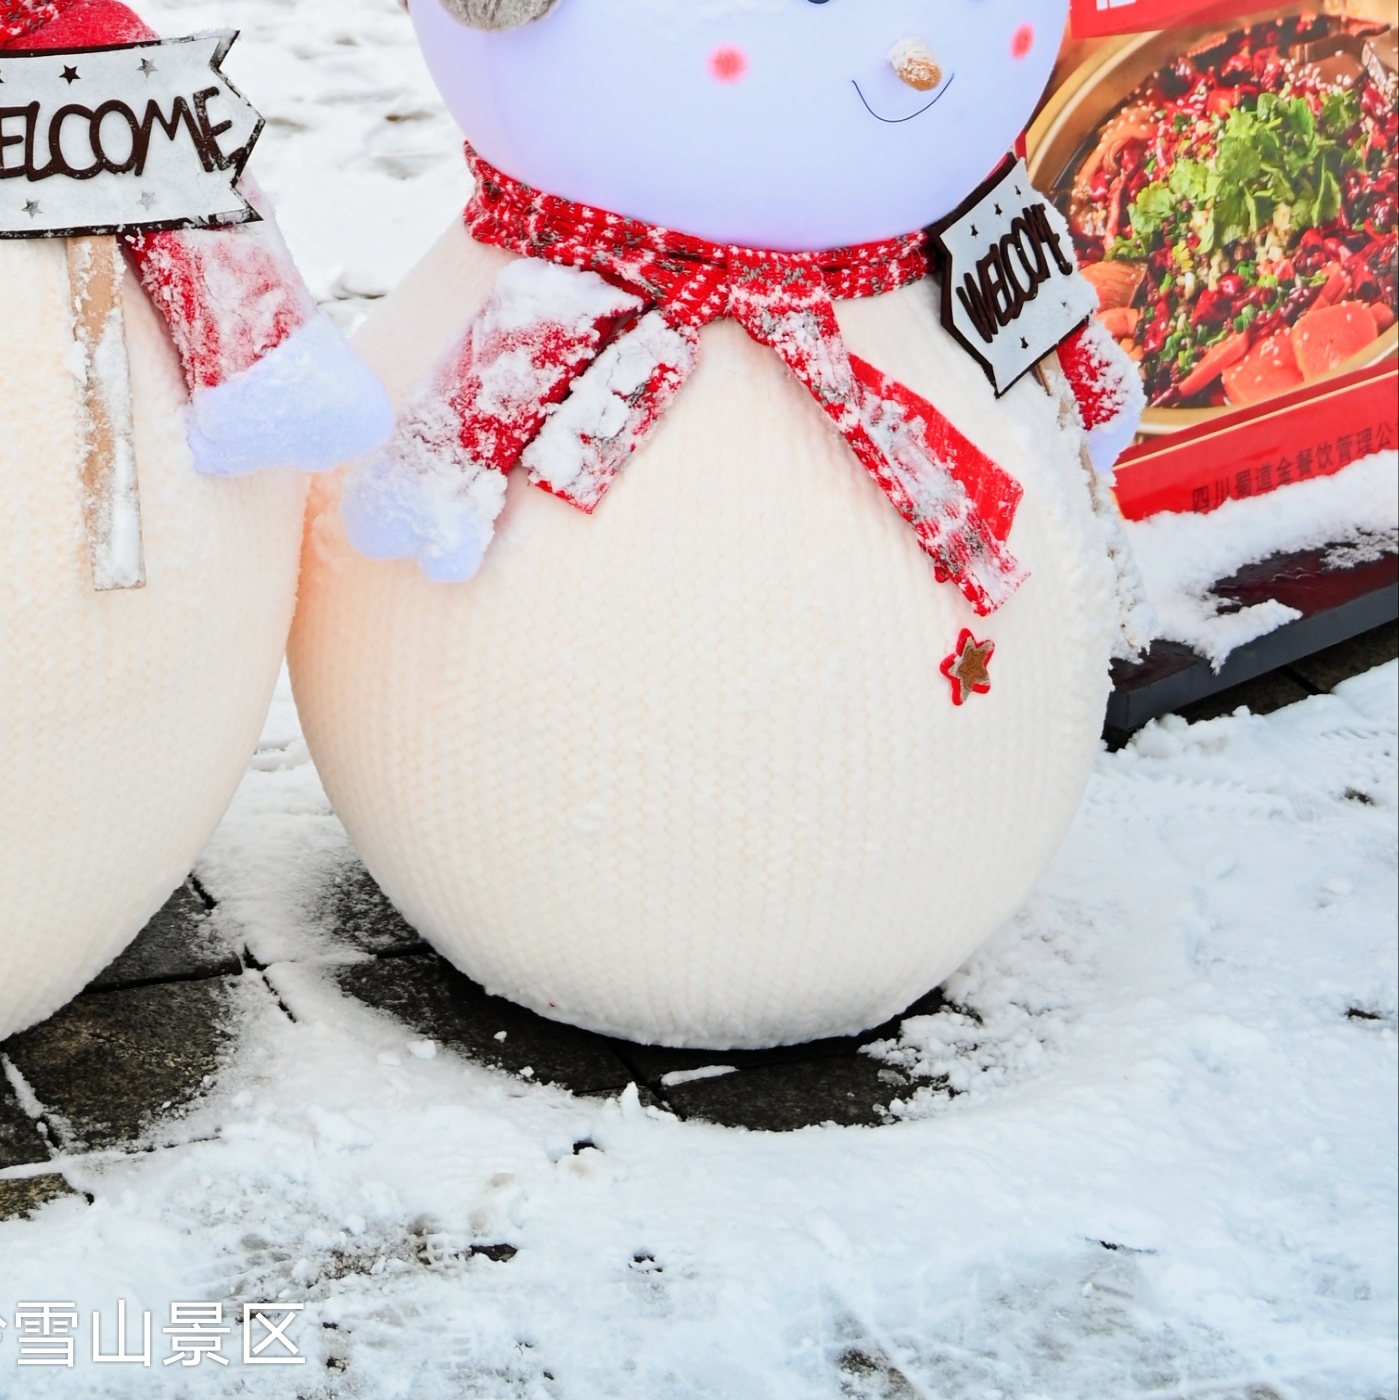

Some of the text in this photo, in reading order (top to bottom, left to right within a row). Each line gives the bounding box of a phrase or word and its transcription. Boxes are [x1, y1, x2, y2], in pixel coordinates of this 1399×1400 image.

[1192, 417, 1398, 514] 四川蜀道金餐饮管理公
